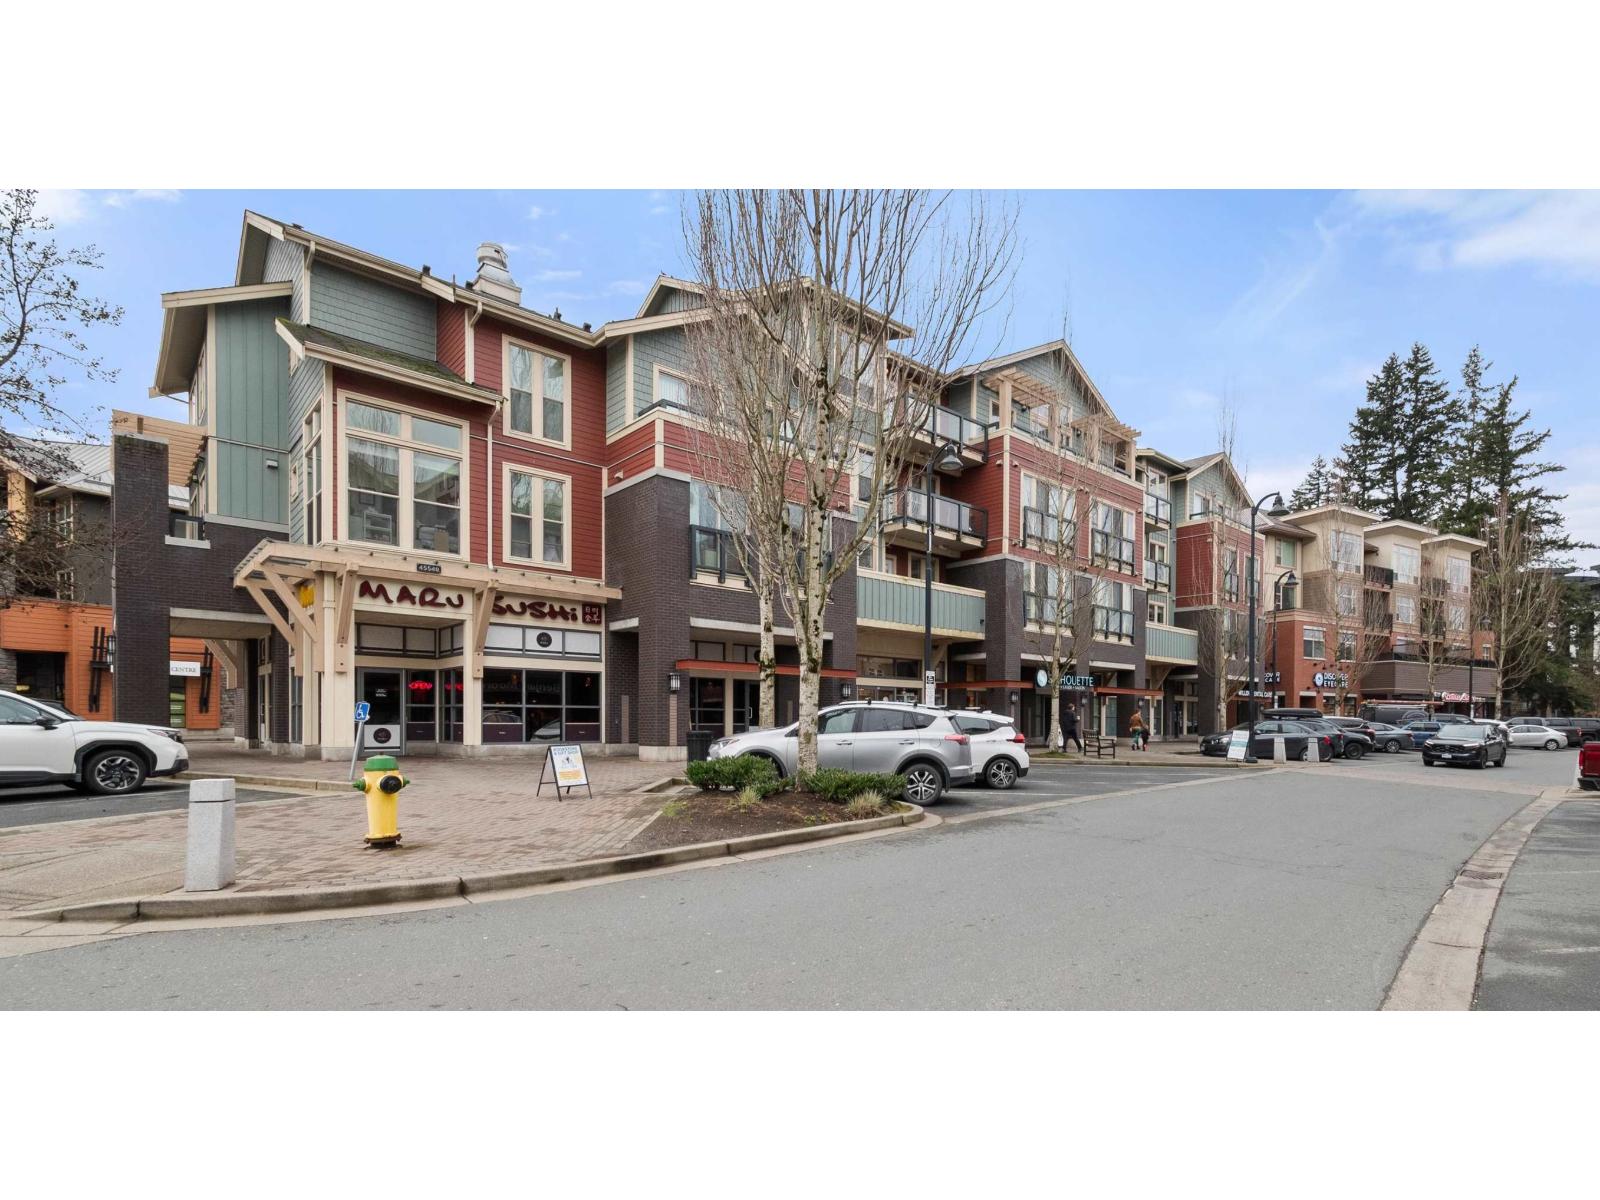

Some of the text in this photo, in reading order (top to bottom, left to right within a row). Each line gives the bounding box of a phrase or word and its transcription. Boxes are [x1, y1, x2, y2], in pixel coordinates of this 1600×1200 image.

[359, 580, 464, 609] MARU
[408, 680, 433, 689] OPEN
[1048, 674, 1093, 686] SHOUETTE
